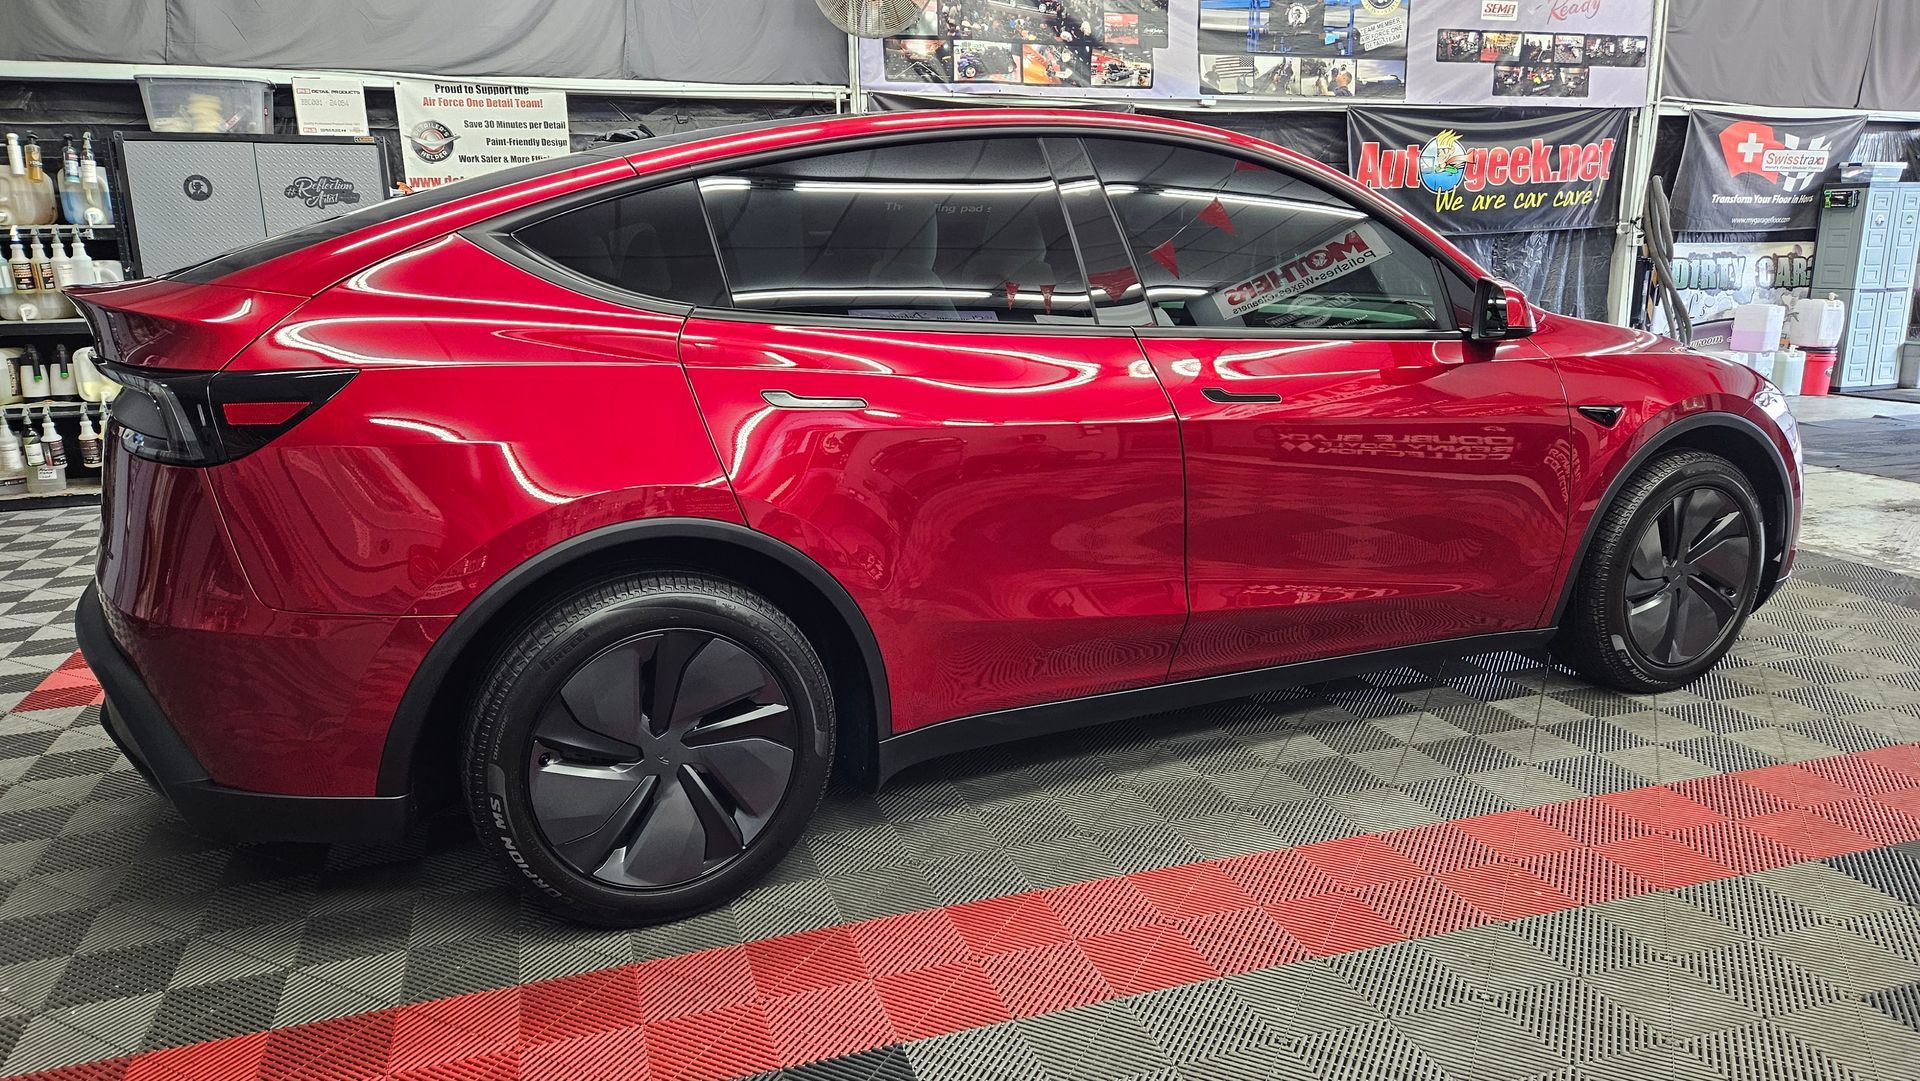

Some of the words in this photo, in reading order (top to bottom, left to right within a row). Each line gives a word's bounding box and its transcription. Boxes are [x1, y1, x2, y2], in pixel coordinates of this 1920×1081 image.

[1484, 3, 1516, 14] SEMA
[1360, 24, 1376, 35] TEAM
[1376, 17, 1401, 30] MEMBER
[1361, 34, 1370, 42] AIR
[1371, 28, 1390, 39] FORCE
[1390, 24, 1403, 33] ONE
[1365, 38, 1385, 50] DETAIL
[1385, 33, 1401, 43] TEAM
[434, 84, 462, 95] Proud
[464, 84, 474, 94] to
[476, 85, 512, 96] Support
[513, 86, 529, 95] the
[423, 97, 437, 106] Air
[438, 97, 465, 107] Force
[466, 98, 485, 107] One
[486, 98, 513, 108] Detail
[515, 99, 543, 108] Team!
[463, 120, 483, 129] Save
[484, 120, 495, 129] 30
[496, 120, 527, 129] Minutes
[529, 121, 542, 130] per
[543, 121, 566, 130] Detail
[486, 137, 540, 147] Paint-Friendly
[541, 138, 568, 147] Design
[420, 150, 448, 161] HELPER
[458, 155, 479, 163] Work
[481, 155, 501, 163] Safer
[510, 155, 530, 163] More
[1766, 152, 1820, 166] Swisstrax
[1434, 186, 1464, 212] We
[1471, 192, 1506, 212] are
[1514, 191, 1546, 209] car
[1553, 178, 1604, 207] care!
[1711, 194, 1753, 204] Transform
[1754, 194, 1771, 204] Your
[1771, 194, 1791, 204] Floor
[1791, 194, 1799, 203] in
[1672, 255, 1746, 290] DIRTY
[490, 797, 507, 830] MS
